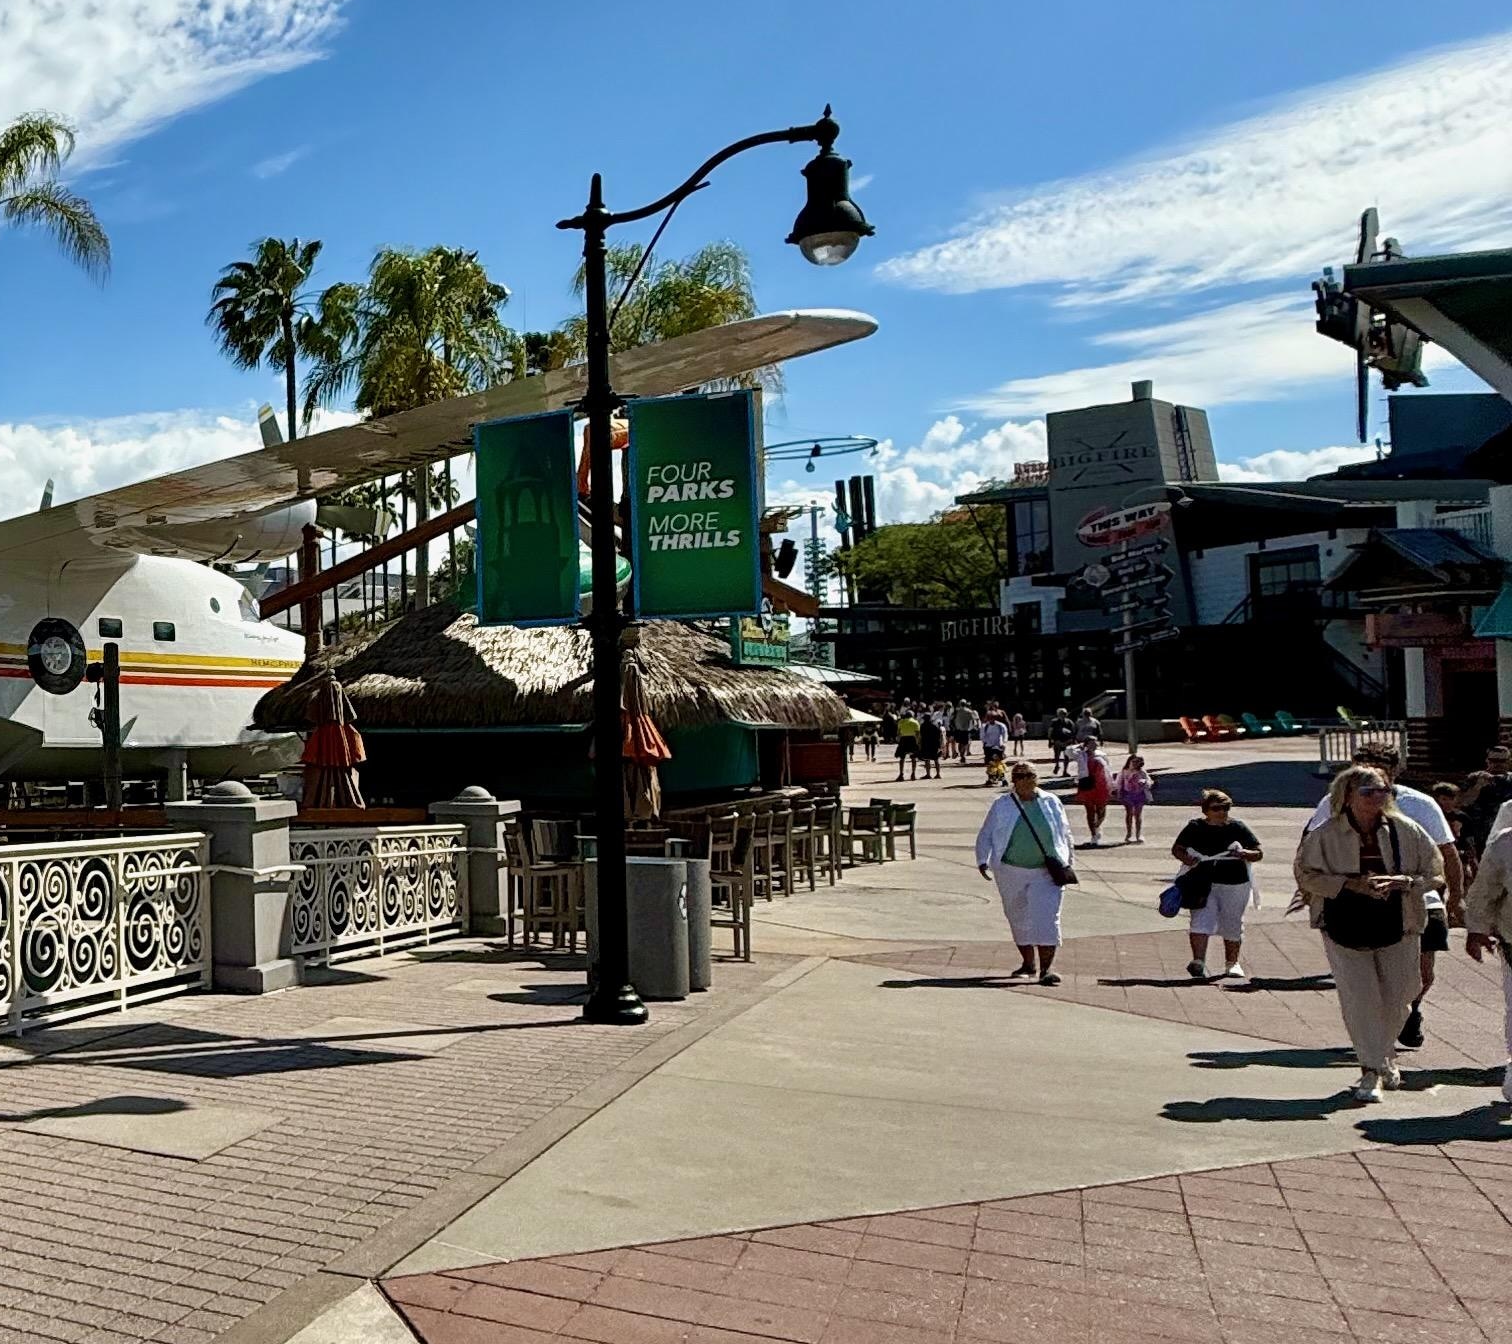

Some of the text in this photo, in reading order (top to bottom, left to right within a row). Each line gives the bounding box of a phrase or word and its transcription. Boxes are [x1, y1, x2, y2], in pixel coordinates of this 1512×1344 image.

[1051, 446, 1157, 469] BIGFIRE
[647, 461, 712, 484] FOUR
[647, 479, 735, 504] PARKS
[649, 511, 720, 534] MORE
[1124, 506, 1156, 523] WAY
[648, 529, 741, 552] THRILLS
[940, 615, 1016, 643] BIGFIRE
